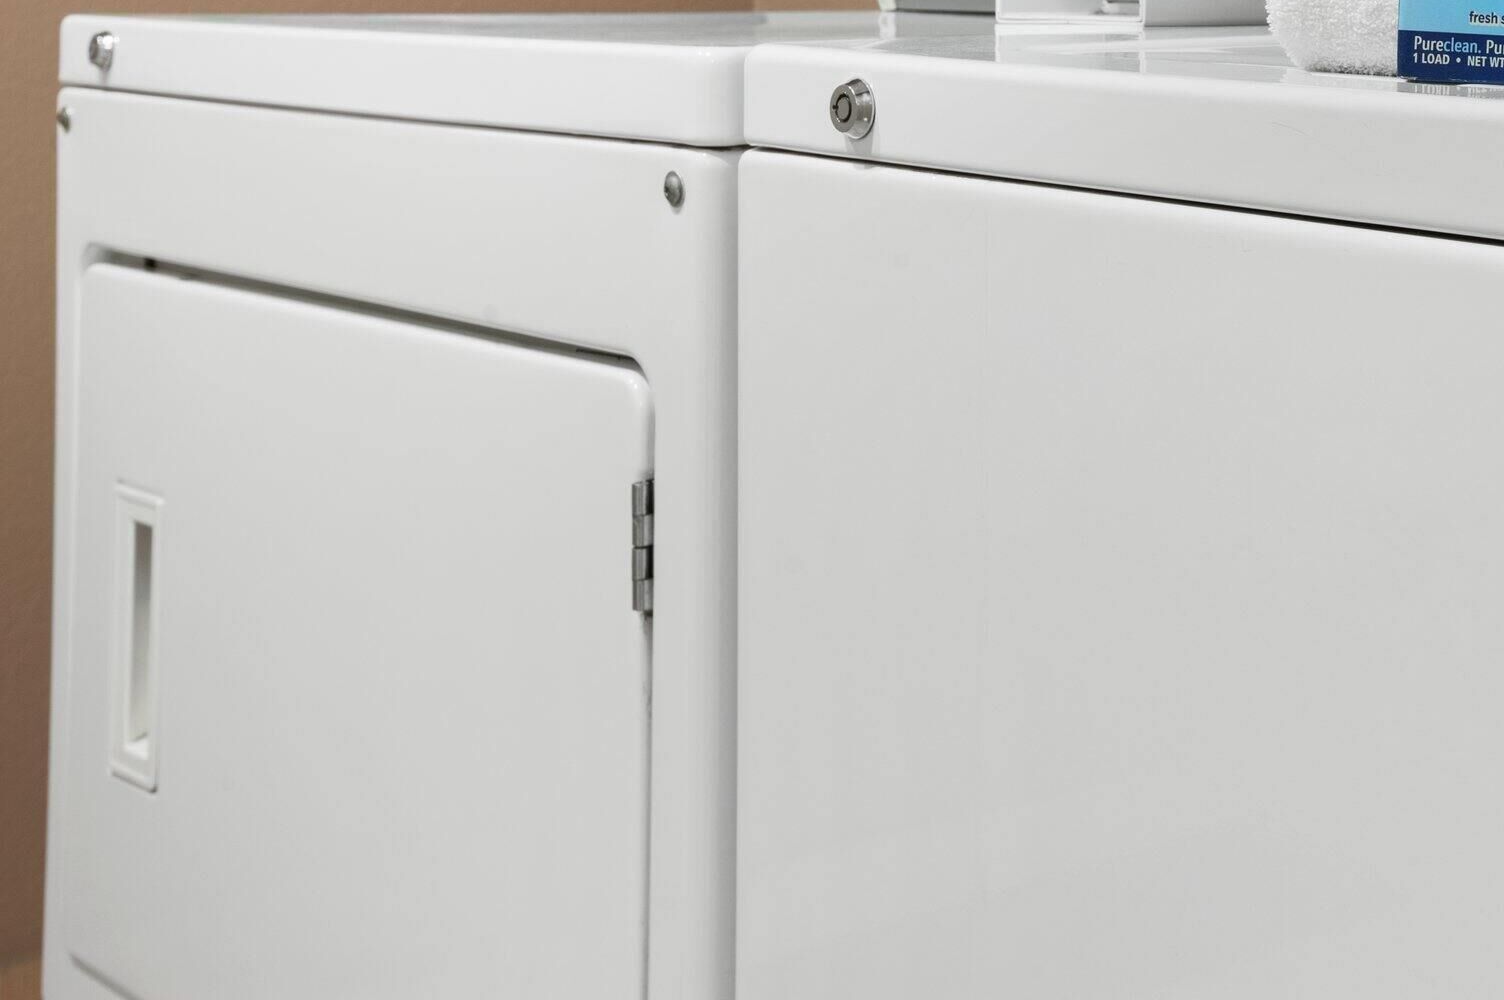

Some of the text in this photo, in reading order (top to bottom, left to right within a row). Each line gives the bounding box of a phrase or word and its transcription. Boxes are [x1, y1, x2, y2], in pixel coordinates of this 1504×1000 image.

[1469, 10, 1498, 26] fresh
[1413, 35, 1482, 53] Pureclean.
[1413, 52, 1418, 64] 1
[1421, 53, 1451, 65] LOAD
[1467, 56, 1487, 68] NET
